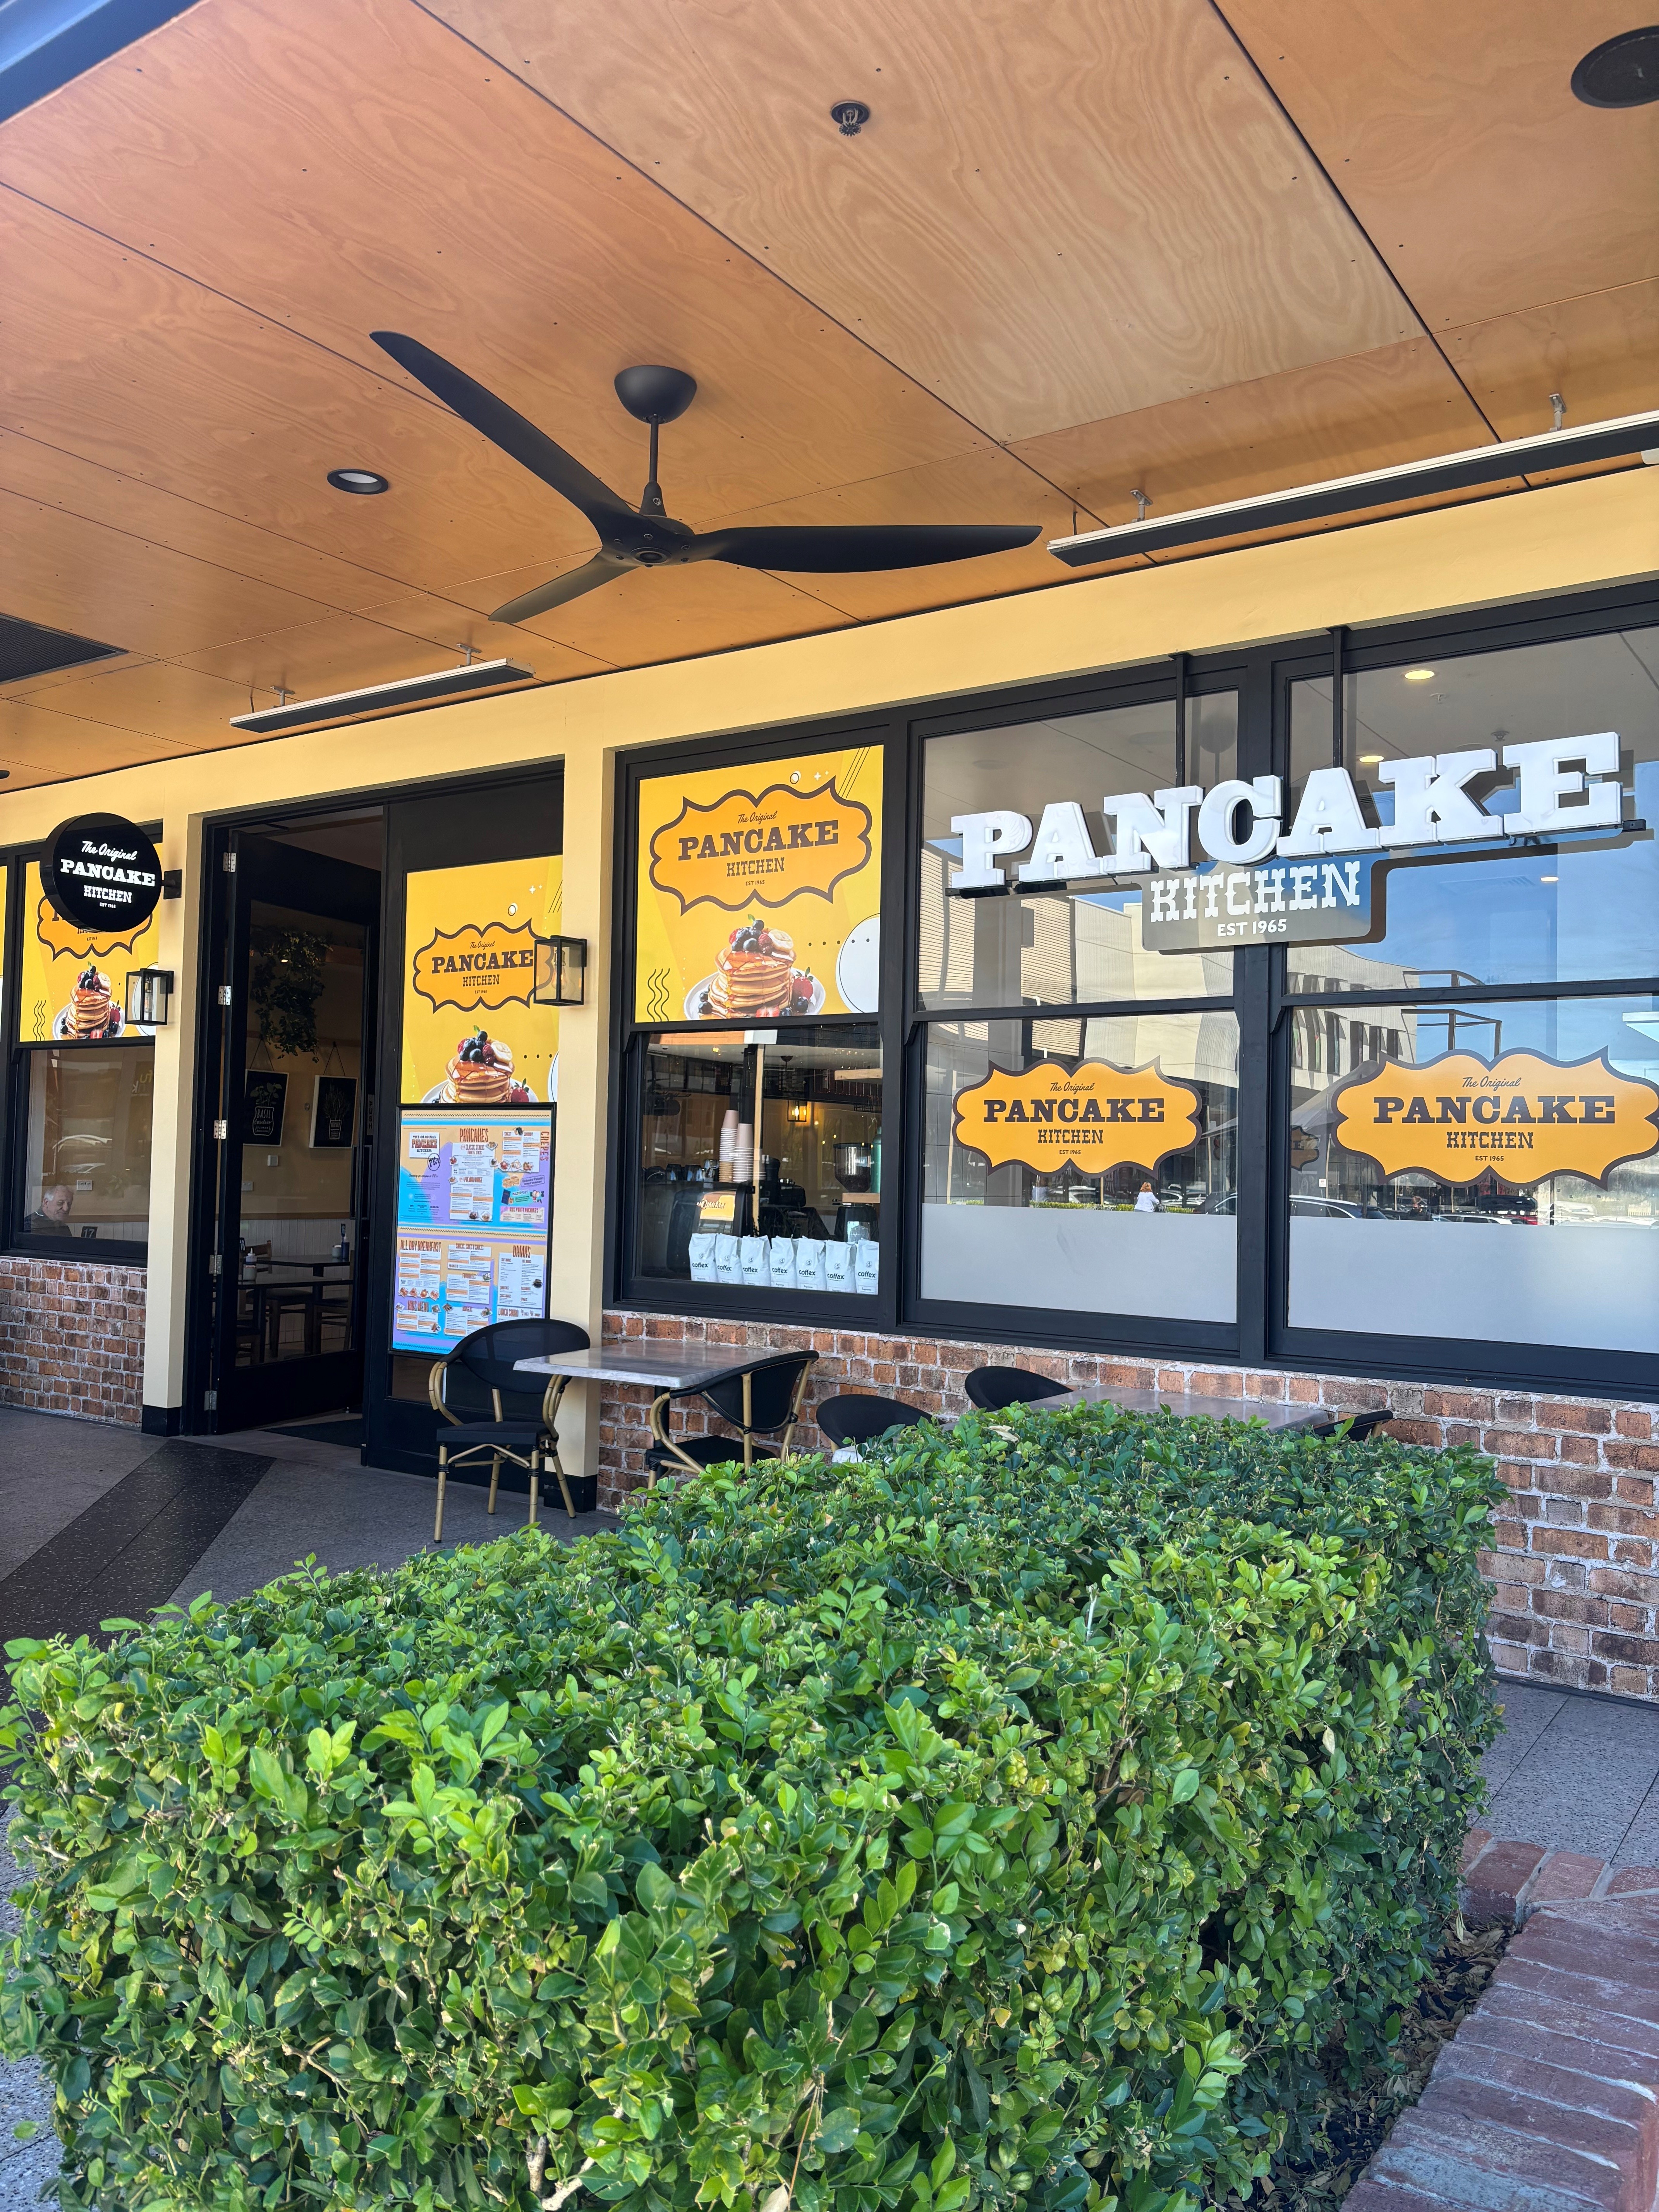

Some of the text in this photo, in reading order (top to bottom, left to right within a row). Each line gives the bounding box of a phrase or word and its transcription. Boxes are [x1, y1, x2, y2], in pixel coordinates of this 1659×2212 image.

[738, 811, 778, 824] The Original
[951, 731, 1621, 890] PANCAKE
[678, 819, 838, 860] PANCAKE
[81, 841, 138, 862] The Original
[60, 859, 155, 887] PANCAKE
[726, 857, 785, 877] KITCHEN
[84, 885, 132, 903] KITCHEN
[1151, 861, 1360, 924] KITCHEN
[1217, 918, 1288, 938] EST 1965
[477, 940, 495, 950] Original
[431, 950, 534, 974] PANCAKE
[462, 974, 500, 987] KITCHEN
[1050, 1082, 1094, 1095] The Original
[1462, 1075, 1522, 1092] The Original
[256, 1108, 271, 1119] BASIL
[983, 1098, 1164, 1123] PANCAKE
[1373, 1096, 1615, 1124] PANCAKE
[460, 1128, 488, 1142] PANCAKES
[1037, 1129, 1103, 1144] KITCHEN
[1446, 1131, 1534, 1149] KITCHEN
[412, 1139, 438, 1149] PANCAKE
[84, 1229, 94, 1238] 17
[409, 1240, 417, 1251] DAY
[418, 1241, 441, 1252] BREAKFAST
[513, 1245, 531, 1258] DRINKS
